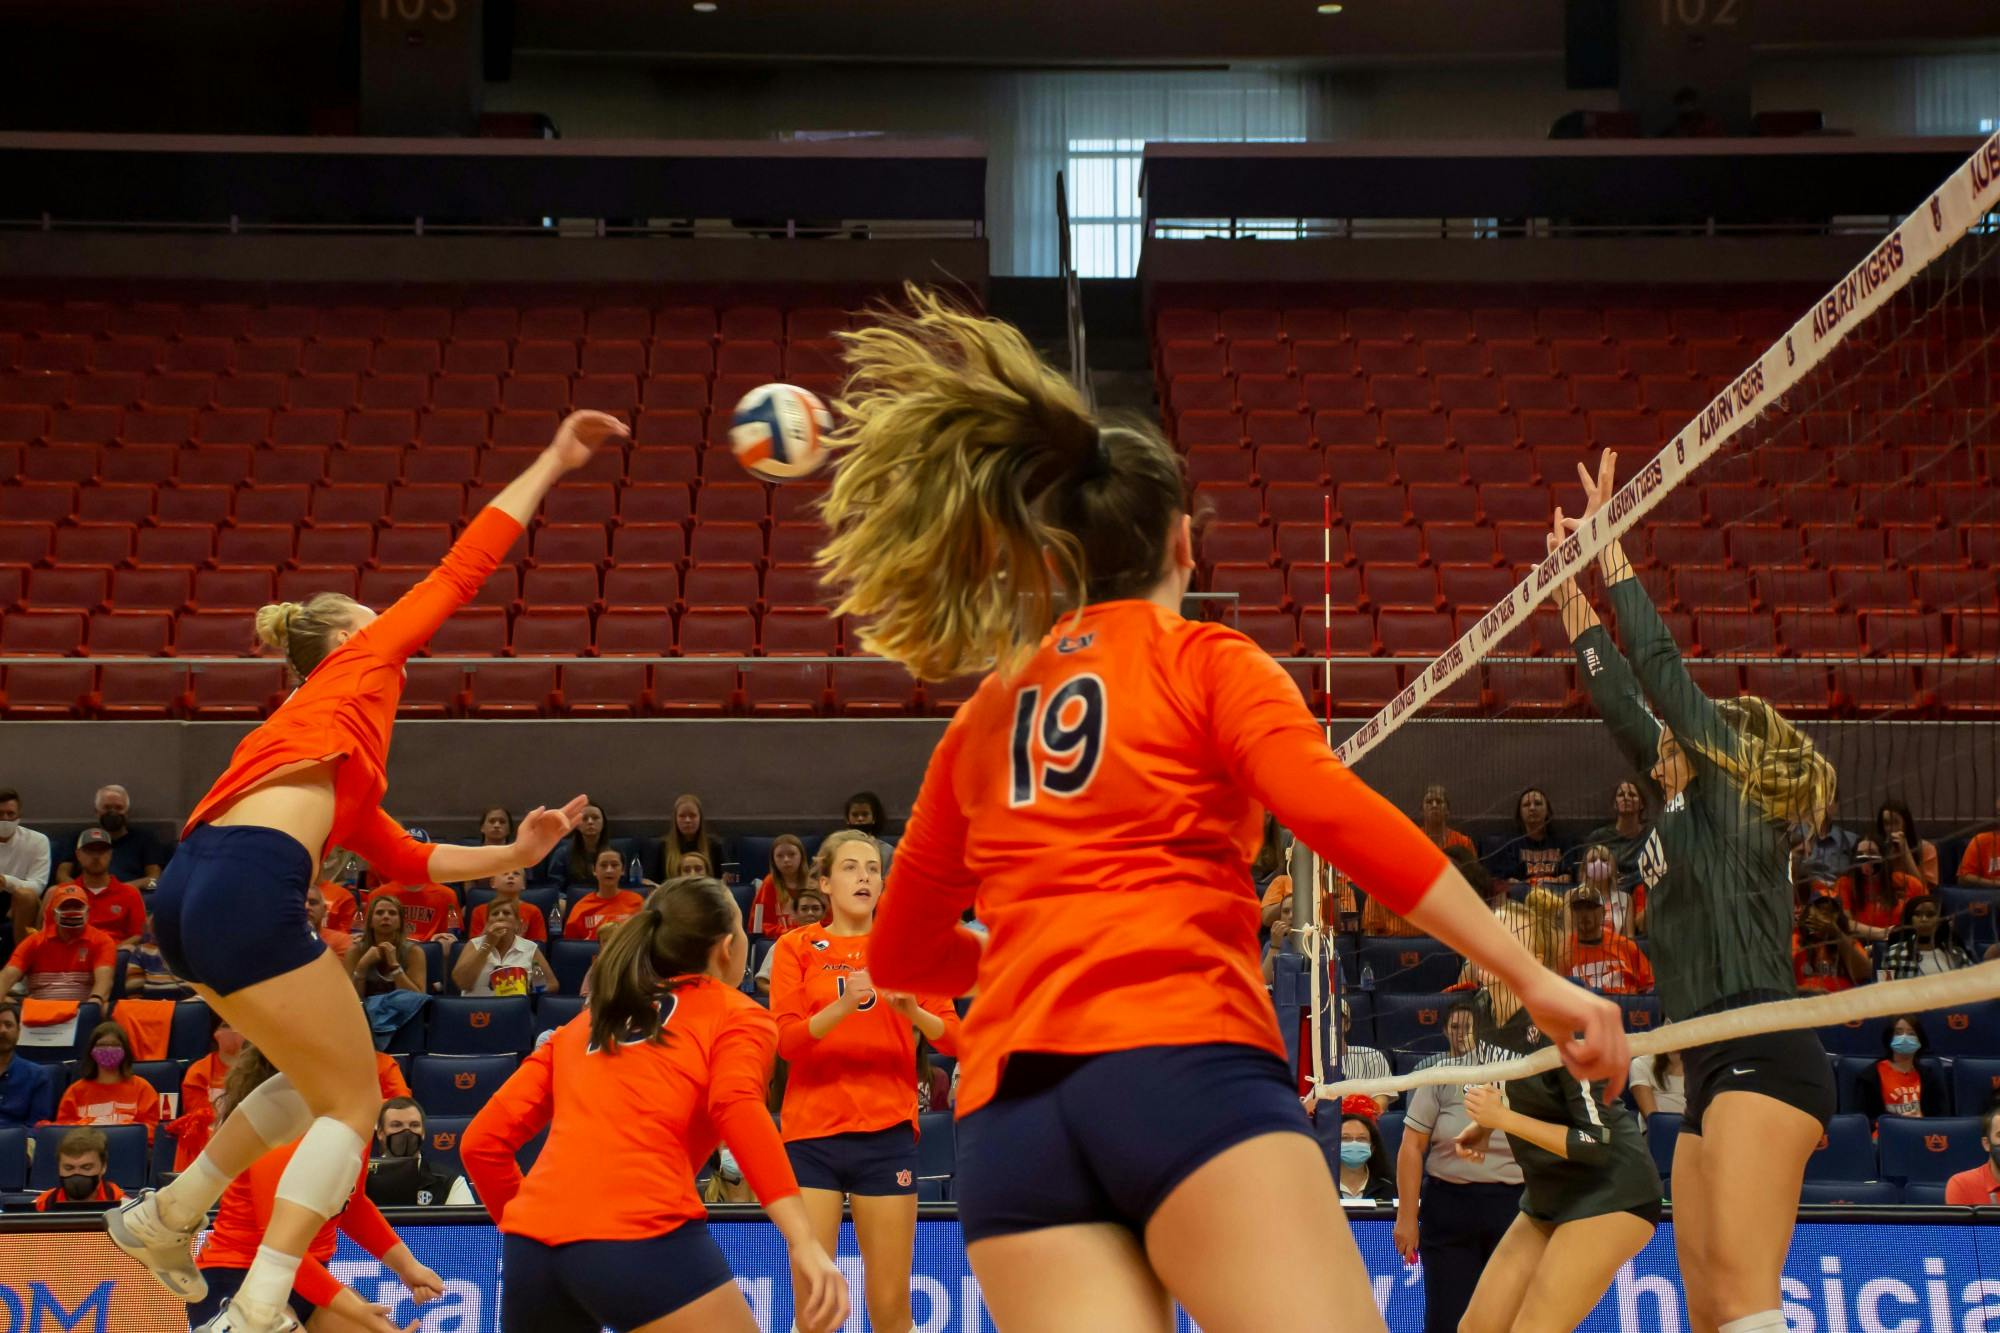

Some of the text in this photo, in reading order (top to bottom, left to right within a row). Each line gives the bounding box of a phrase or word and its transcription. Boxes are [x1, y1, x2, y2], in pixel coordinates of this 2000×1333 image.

[1970, 133, 2000, 200] AUB
[1858, 231, 1904, 301] TIGERS
[1009, 672, 1108, 809] 19
